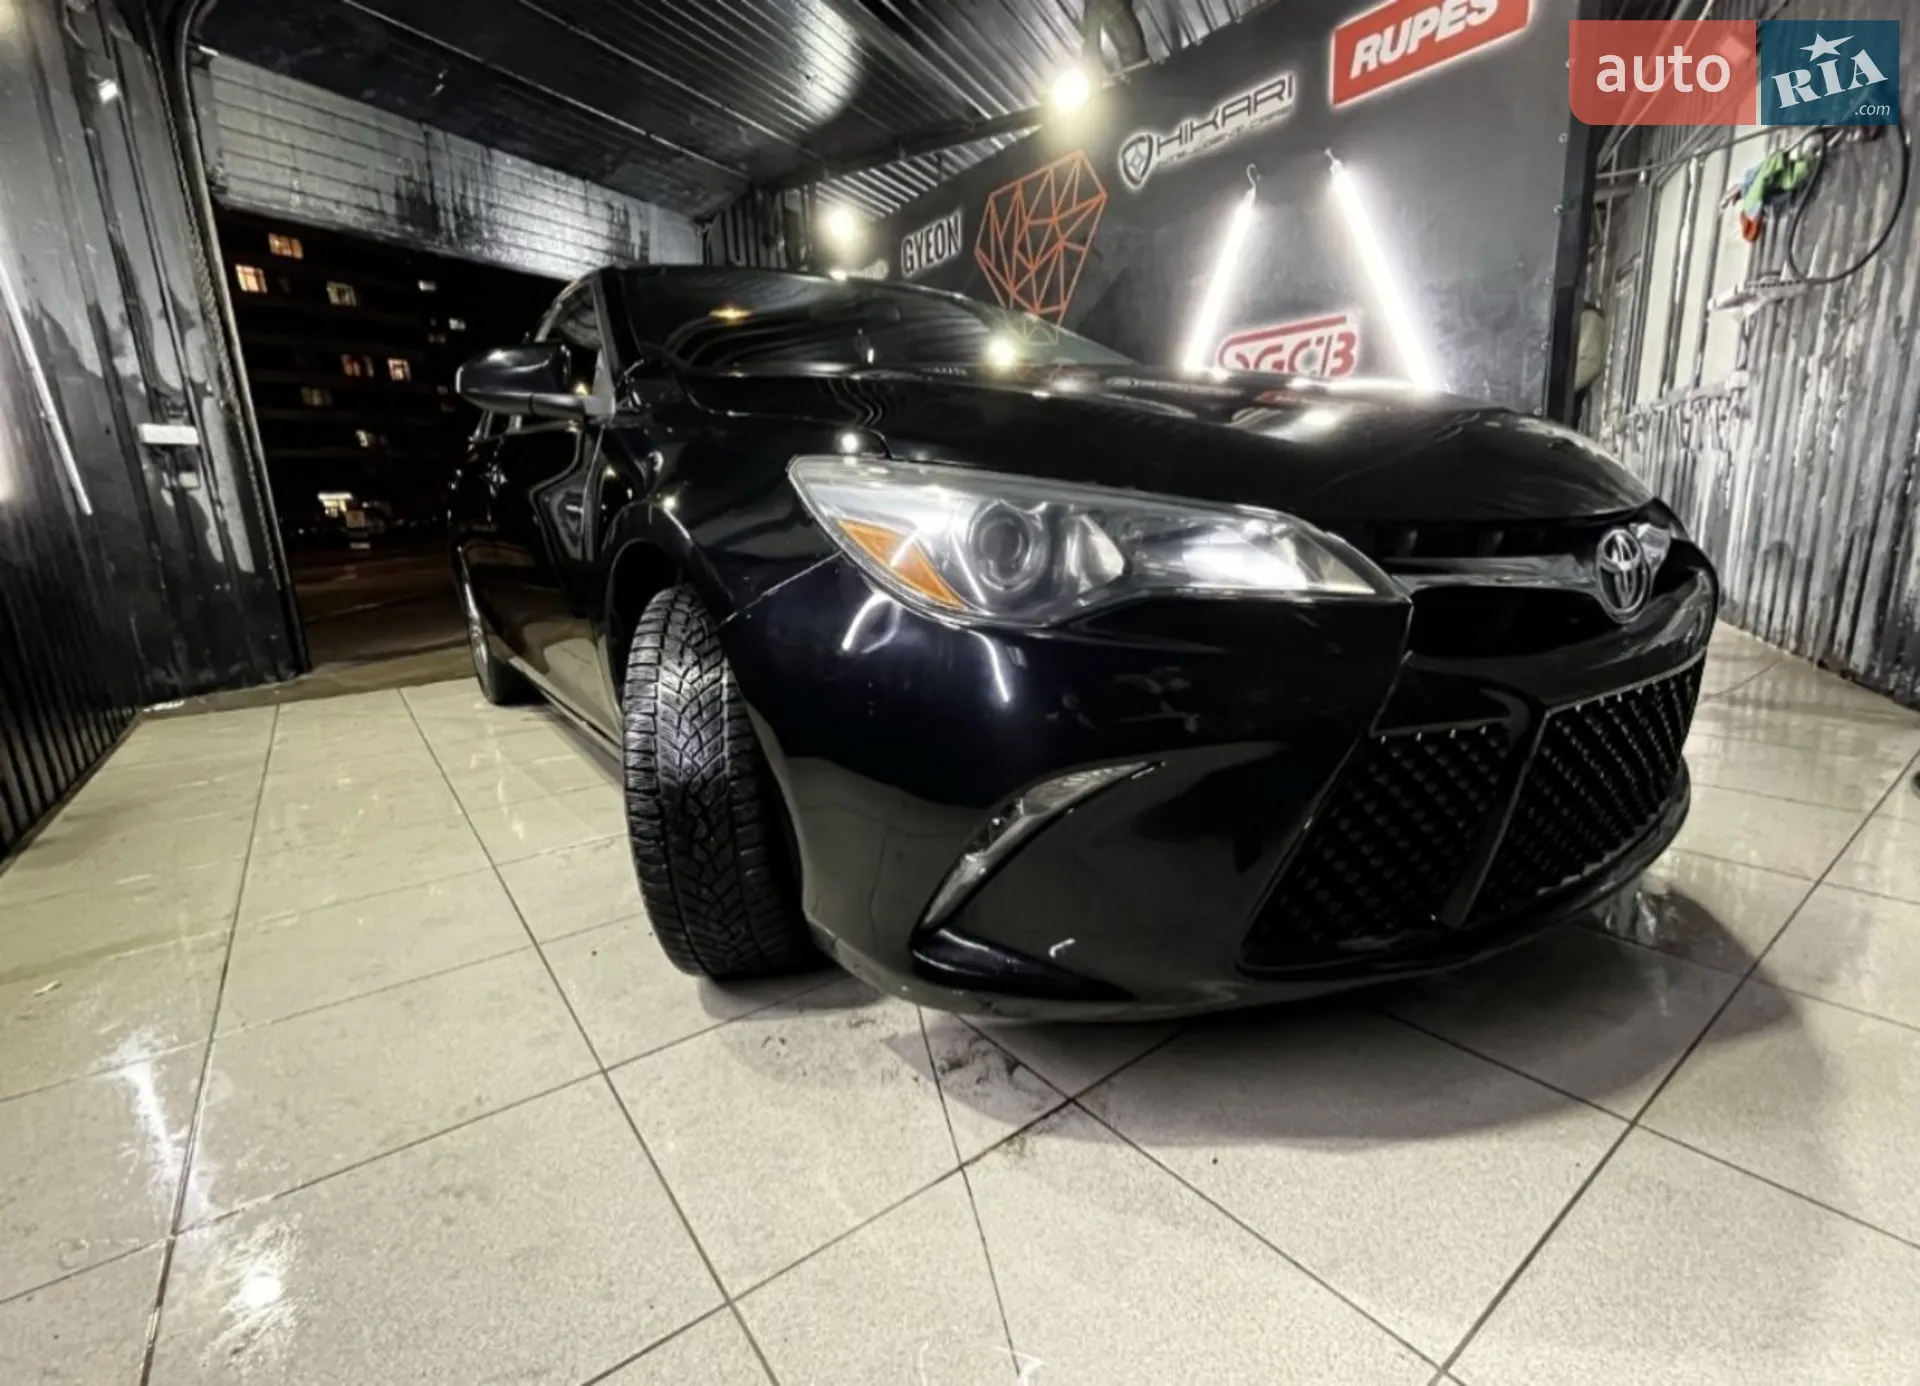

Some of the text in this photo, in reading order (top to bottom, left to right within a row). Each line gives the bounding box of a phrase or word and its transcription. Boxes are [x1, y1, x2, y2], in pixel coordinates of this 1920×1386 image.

[1350, 0, 1498, 79] RUPES
[1157, 75, 1294, 156] HIKARI
[902, 212, 961, 275] GYEON
